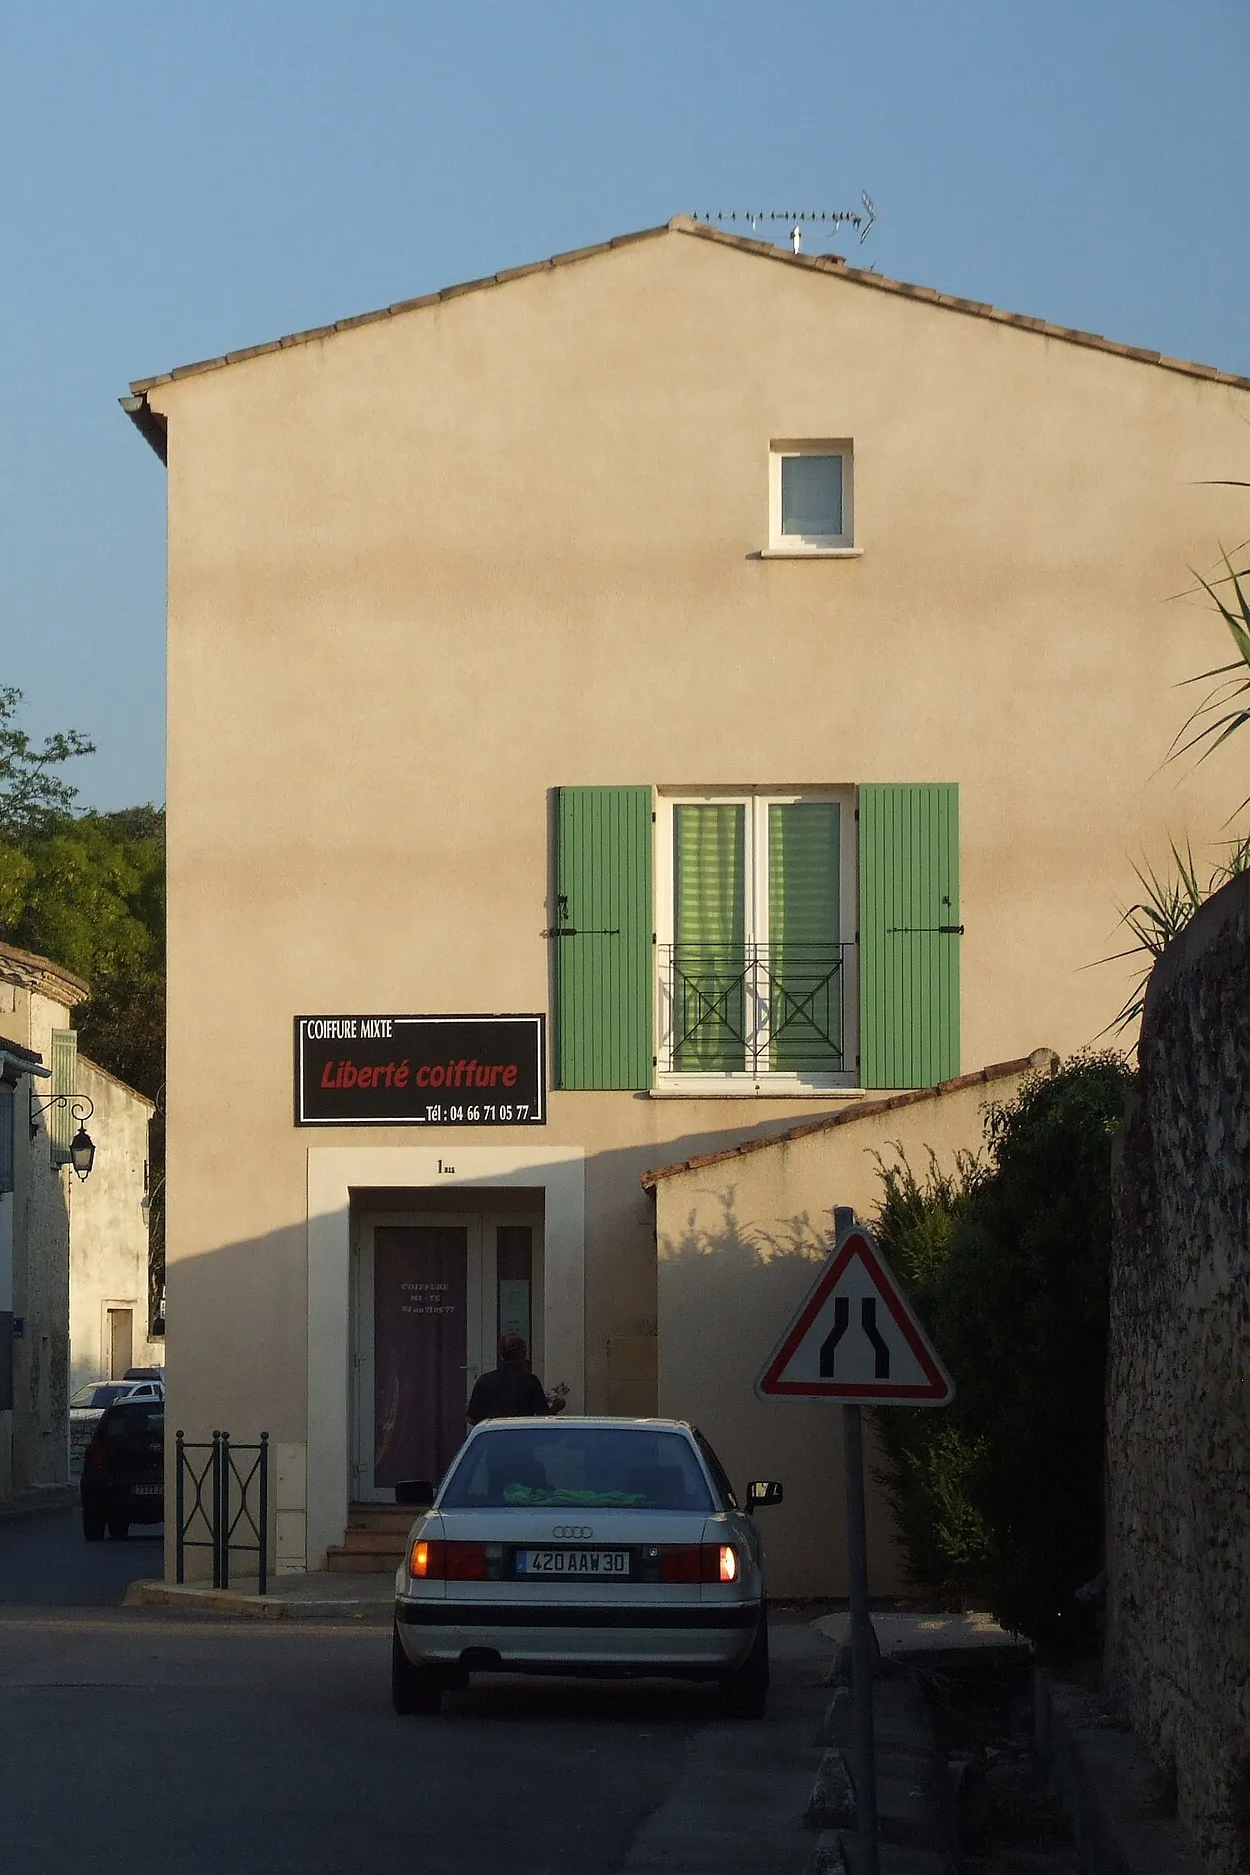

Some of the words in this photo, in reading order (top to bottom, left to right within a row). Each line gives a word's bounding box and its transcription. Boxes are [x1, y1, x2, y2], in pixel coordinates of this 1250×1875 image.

[307, 1020, 357, 1039] COIFFURE
[360, 1019, 393, 1038] MIXTE
[321, 1058, 410, 1089] Liberté
[416, 1059, 518, 1088] coiffure
[450, 1105, 464, 1121] 04
[467, 1105, 480, 1121] 66
[483, 1105, 496, 1121] 71
[499, 1105, 512, 1120] 05
[516, 1105, 529, 1120] 77
[532, 1553, 565, 1571] 420
[568, 1554, 600, 1571] AAW
[603, 1554, 625, 1571] 30
